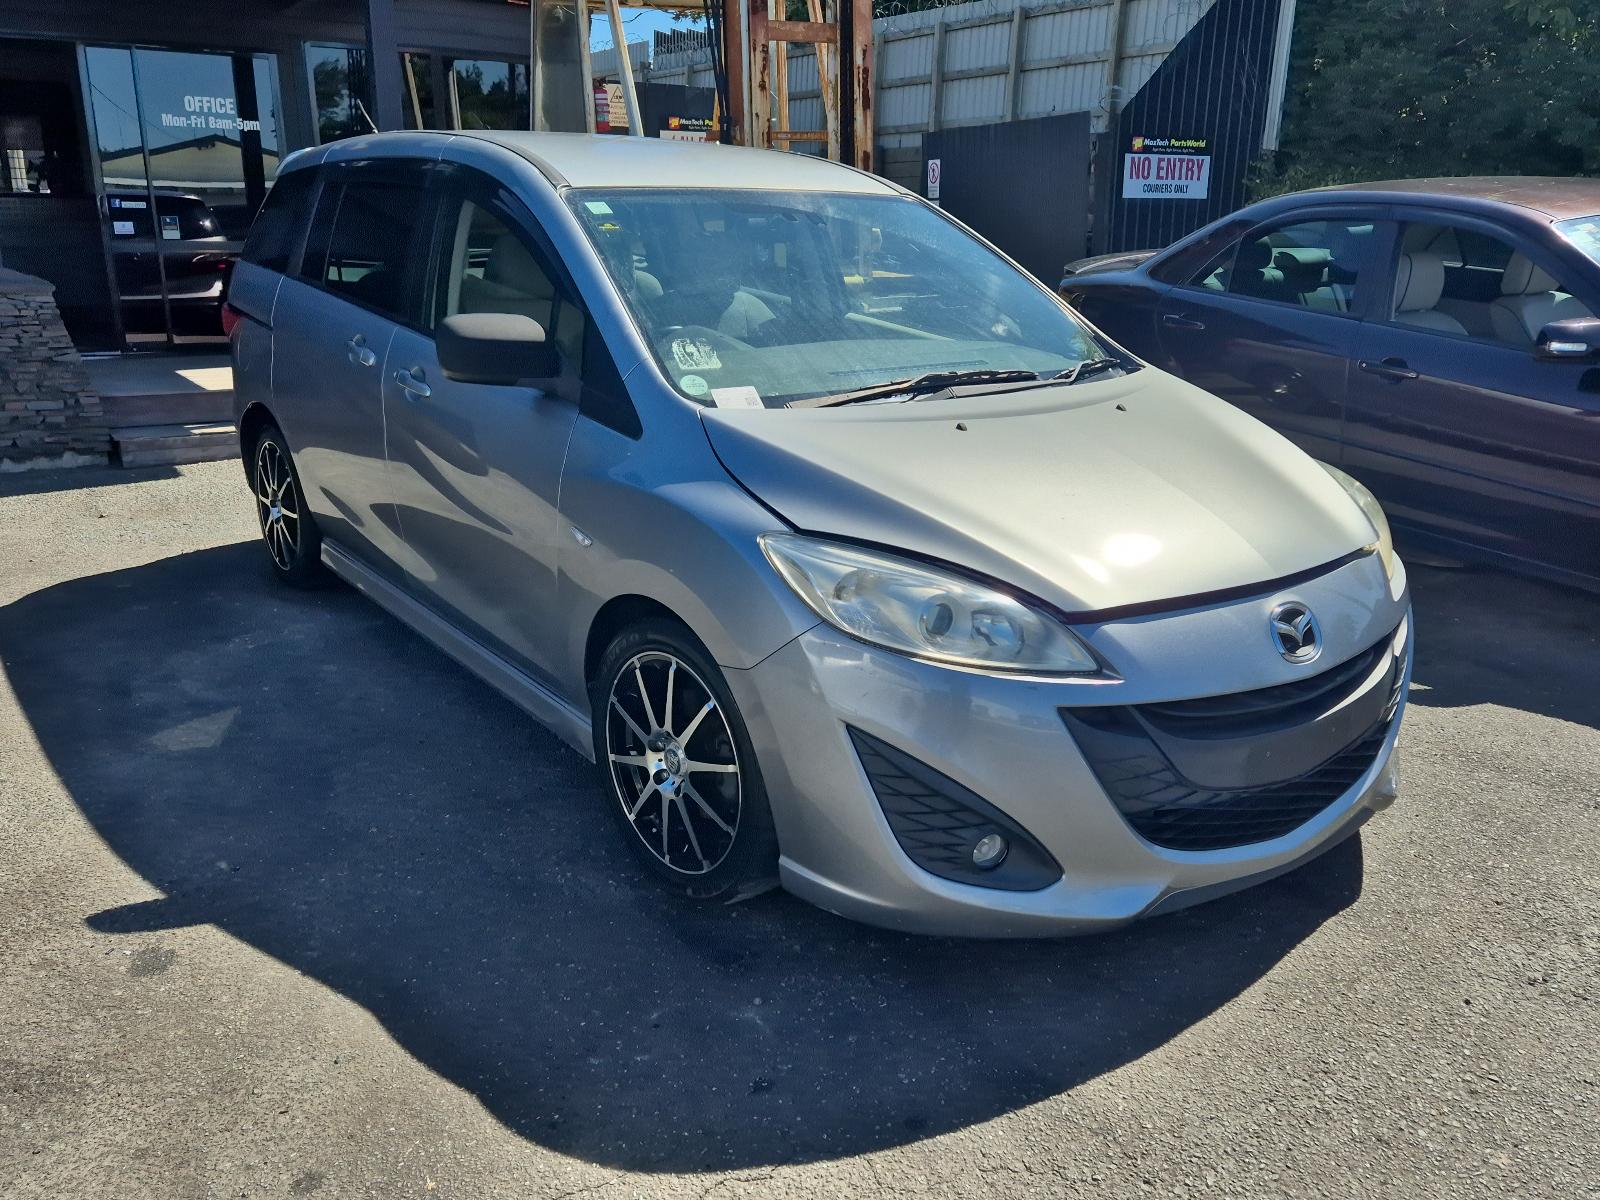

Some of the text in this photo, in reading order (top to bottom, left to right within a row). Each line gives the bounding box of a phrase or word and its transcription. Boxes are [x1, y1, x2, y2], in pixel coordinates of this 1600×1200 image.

[183, 95, 236, 115] OFFICE
[161, 113, 260, 132] Mon-Fri 8am-5pm
[1170, 139, 1206, 148] PartsWorld
[1129, 156, 1205, 181] NO ENTRY
[1142, 183, 1189, 194] COURIERS ONLY
